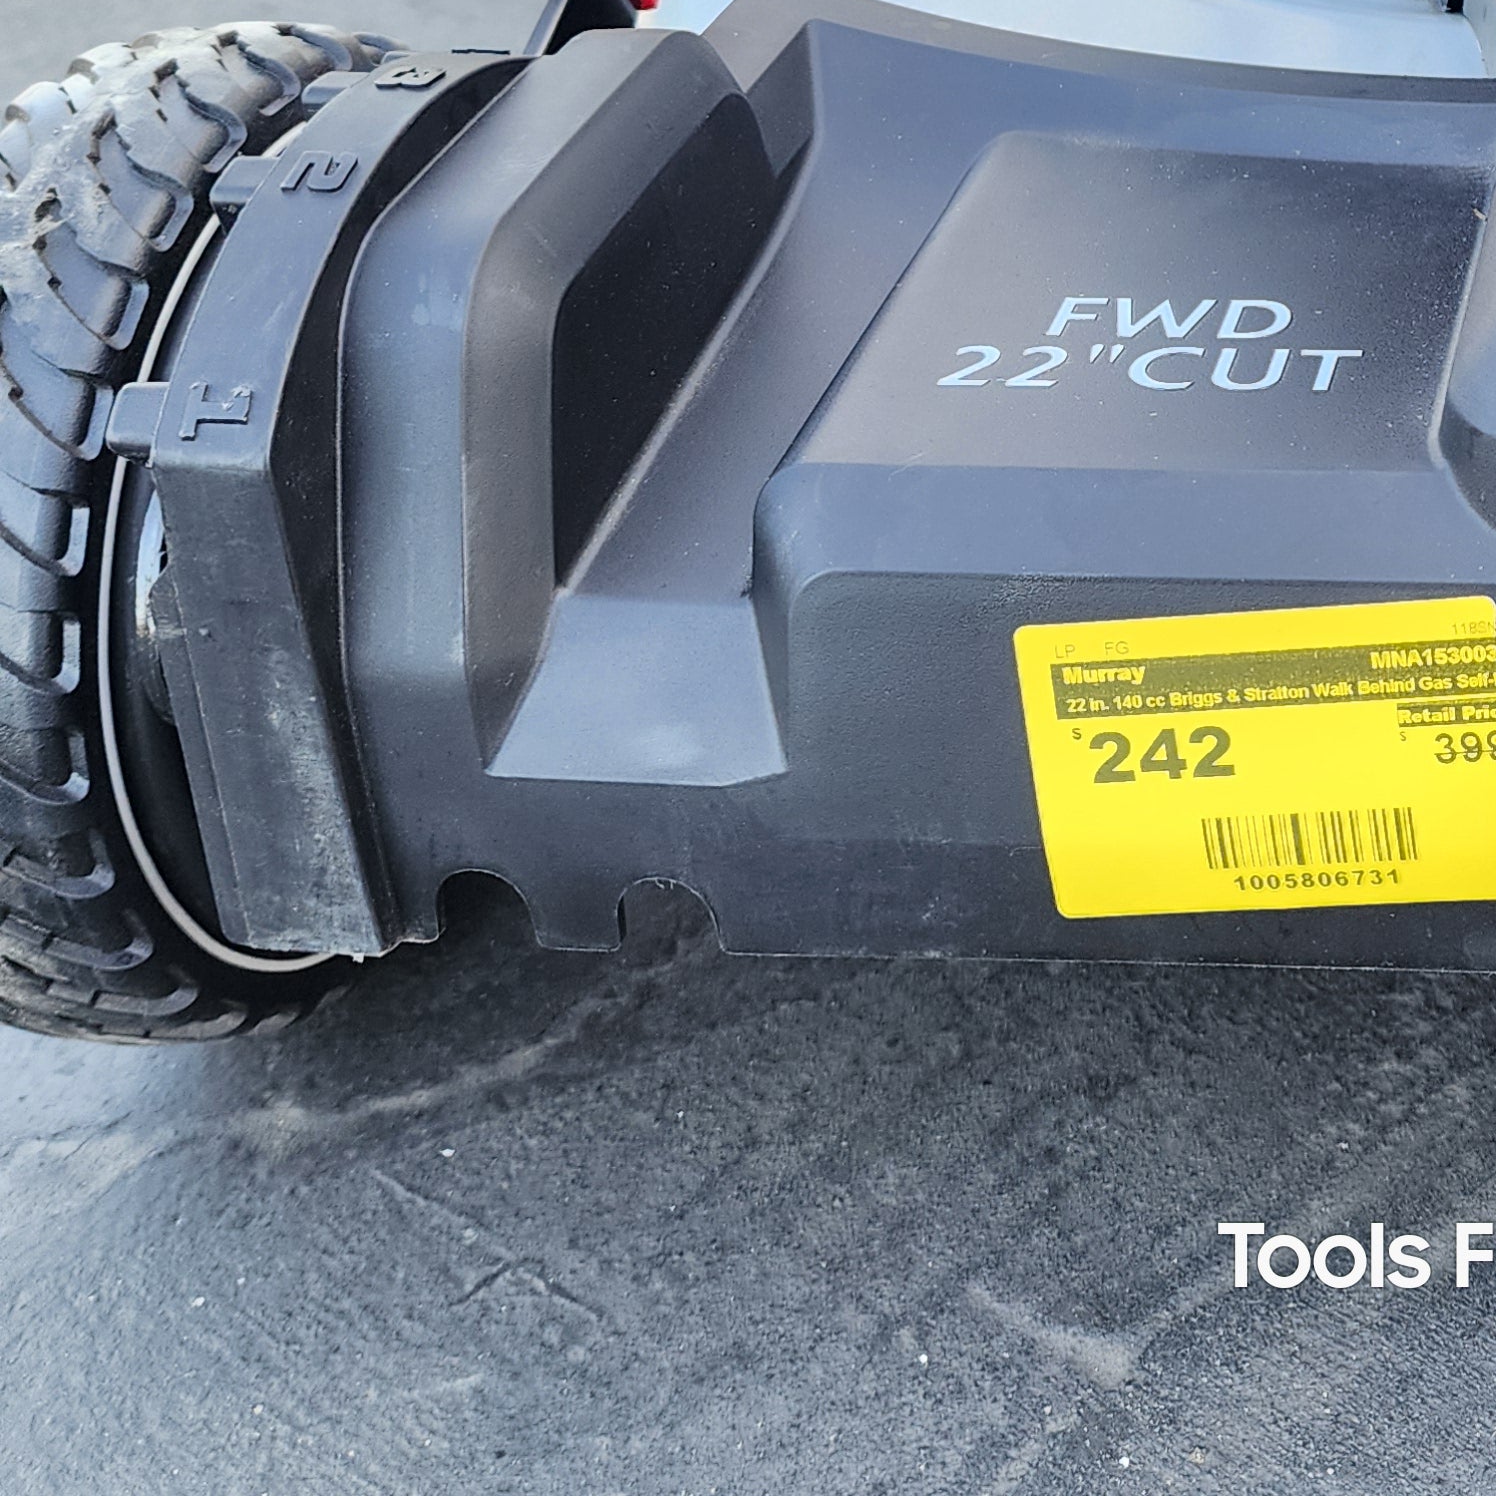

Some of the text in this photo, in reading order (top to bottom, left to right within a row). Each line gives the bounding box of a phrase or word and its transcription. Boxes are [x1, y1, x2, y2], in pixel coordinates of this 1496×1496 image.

[1044, 296, 1294, 340] FWD
[1054, 644, 1076, 659] LP
[1104, 640, 1130, 655] FG
[1062, 665, 1146, 685] Murray
[1066, 698, 1087, 713] 22
[1089, 696, 1110, 712] in.
[1113, 694, 1143, 710] 140
[1146, 696, 1166, 709] cc
[1169, 690, 1223, 709] Briggs
[1226, 688, 1241, 703] &
[1243, 684, 1310, 702] Stratton
[1312, 681, 1353, 699] Walk
[1358, 676, 1416, 695] Behind
[1418, 674, 1453, 691] Gas
[1398, 706, 1456, 725] Retail
[1089, 725, 1236, 784] 242
[1233, 868, 1400, 892] 1005806731
